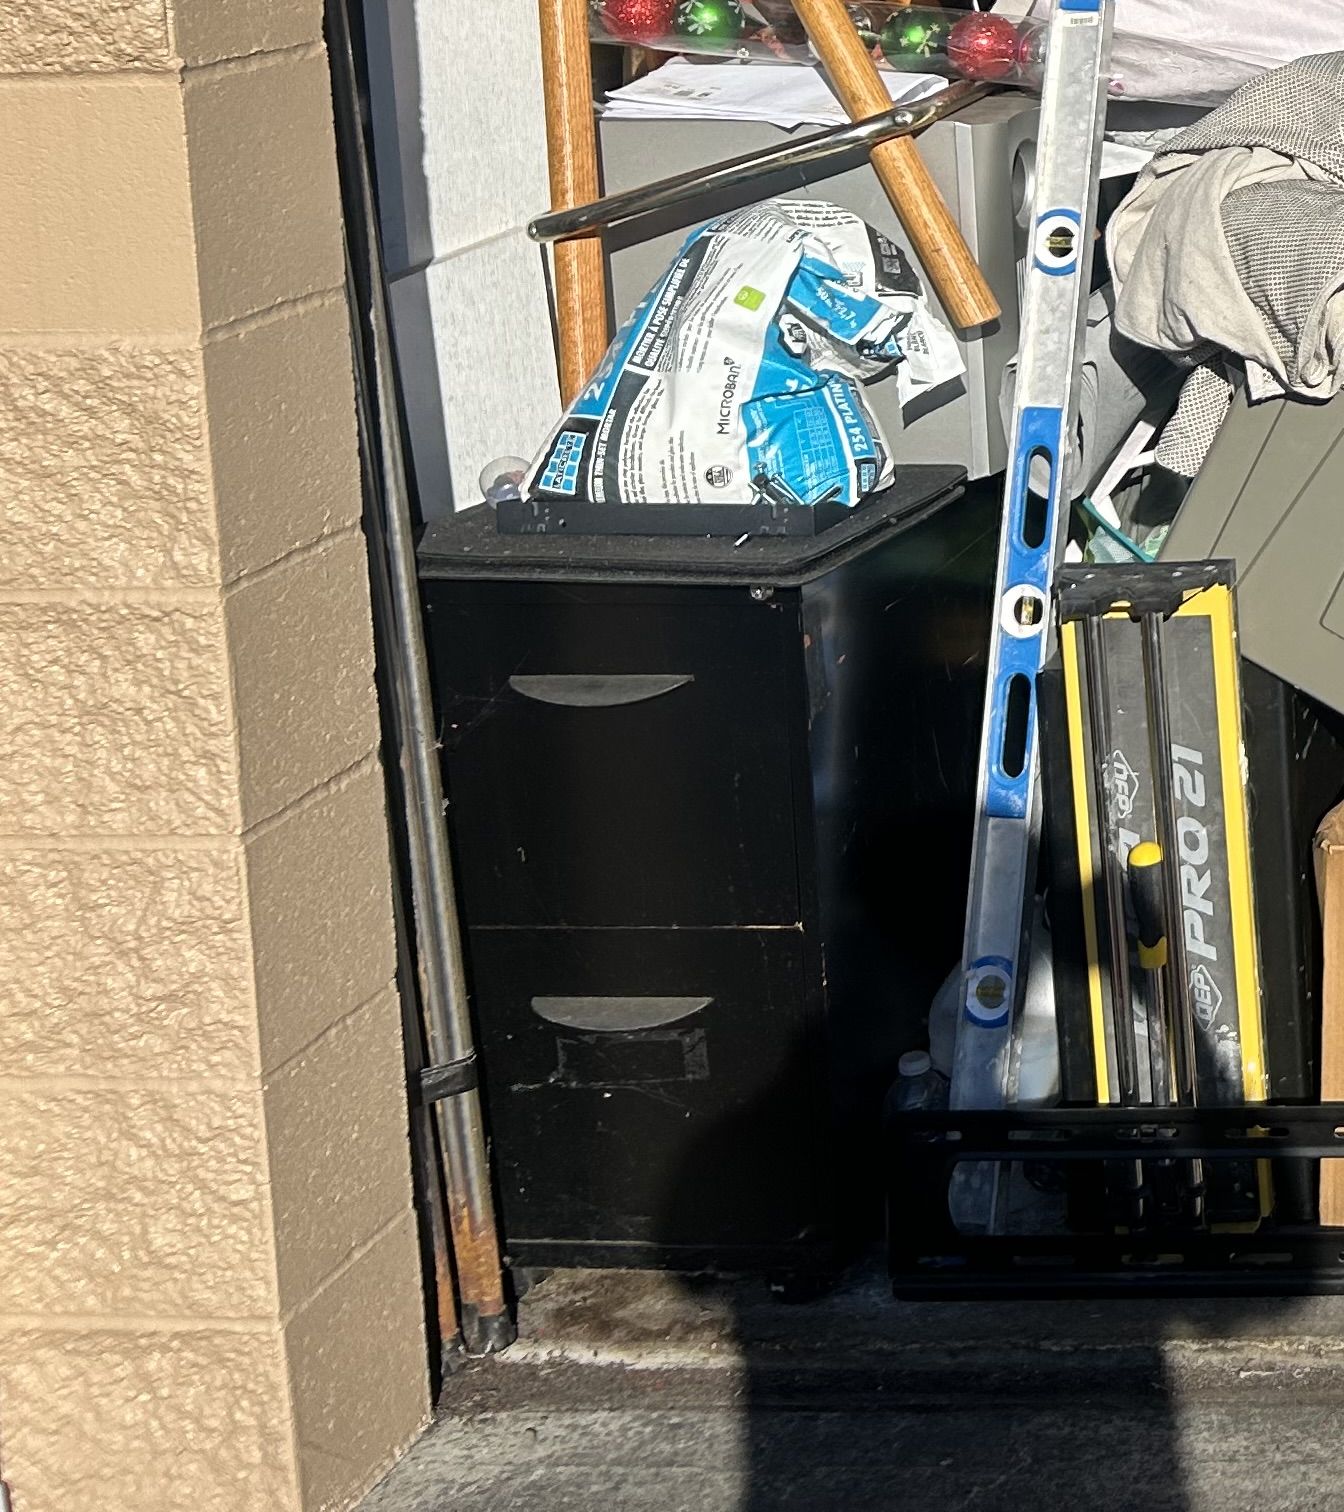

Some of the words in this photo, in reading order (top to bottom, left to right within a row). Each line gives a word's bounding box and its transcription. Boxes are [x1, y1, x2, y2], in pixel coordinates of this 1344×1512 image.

[826, 379, 858, 423] PLATIN
[848, 427, 869, 451] 254
[1170, 740, 1206, 808] 21
[1175, 813, 1217, 963] PRO
[1194, 972, 1214, 1020] QEP
